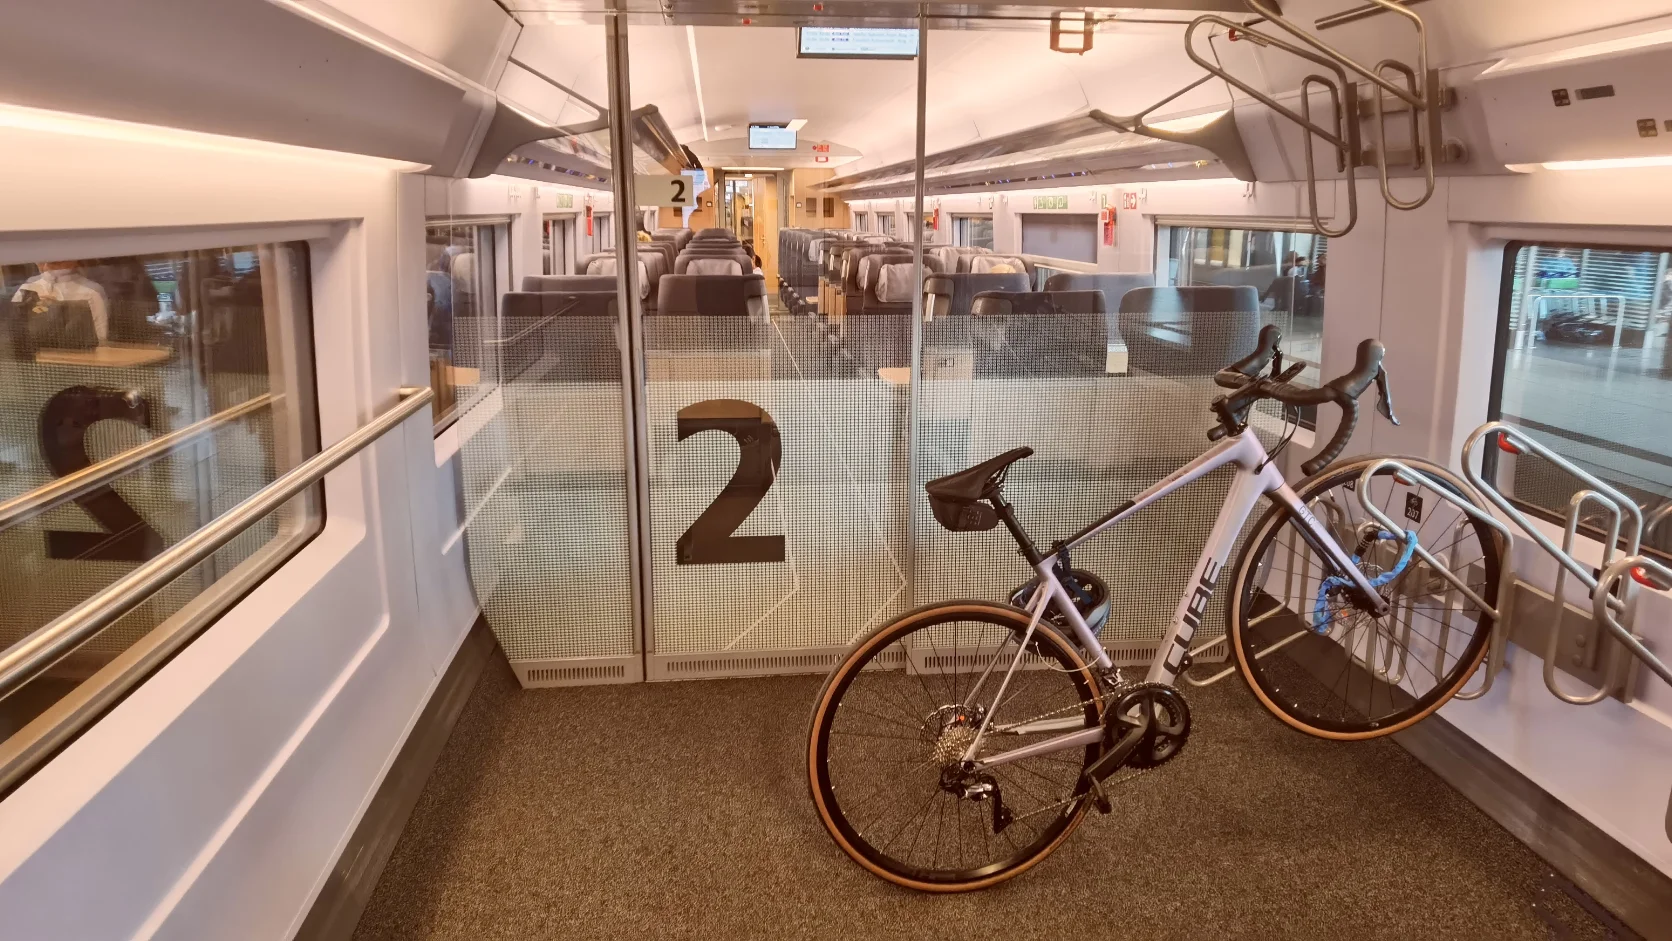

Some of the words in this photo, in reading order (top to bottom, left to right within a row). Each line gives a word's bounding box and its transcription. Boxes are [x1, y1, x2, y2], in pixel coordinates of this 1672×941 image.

[671, 180, 686, 202] 2
[676, 399, 785, 564] 2
[1299, 506, 1316, 526] GTC
[1406, 507, 1420, 520] 207
[1163, 557, 1218, 675] CUBE
